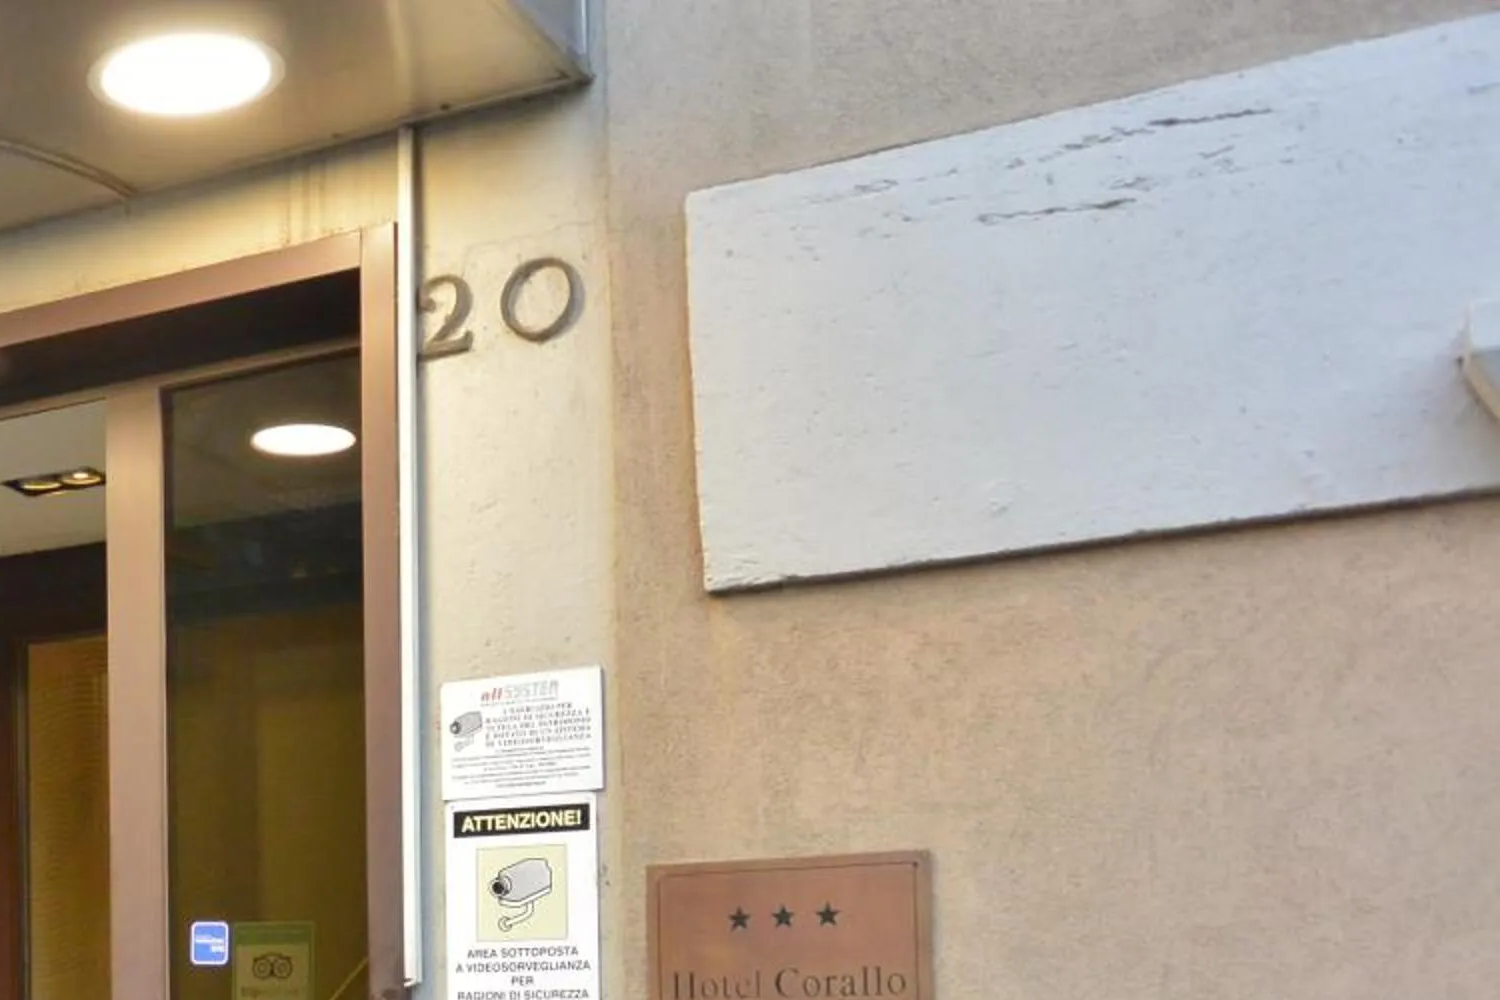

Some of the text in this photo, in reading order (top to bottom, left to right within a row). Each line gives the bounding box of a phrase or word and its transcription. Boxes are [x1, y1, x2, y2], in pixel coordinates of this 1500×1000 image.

[417, 257, 586, 362] 20
[461, 809, 582, 833] ATTENZIONE!
[467, 946, 579, 959] AREA SOTTOPOSTA
[456, 960, 591, 973] A VIDEOSORVEGLIANZA
[511, 976, 534, 986] PER
[673, 965, 907, 1000] Hotel Corallo
[457, 988, 589, 1000] RAGIONI DI SICUREZZA
